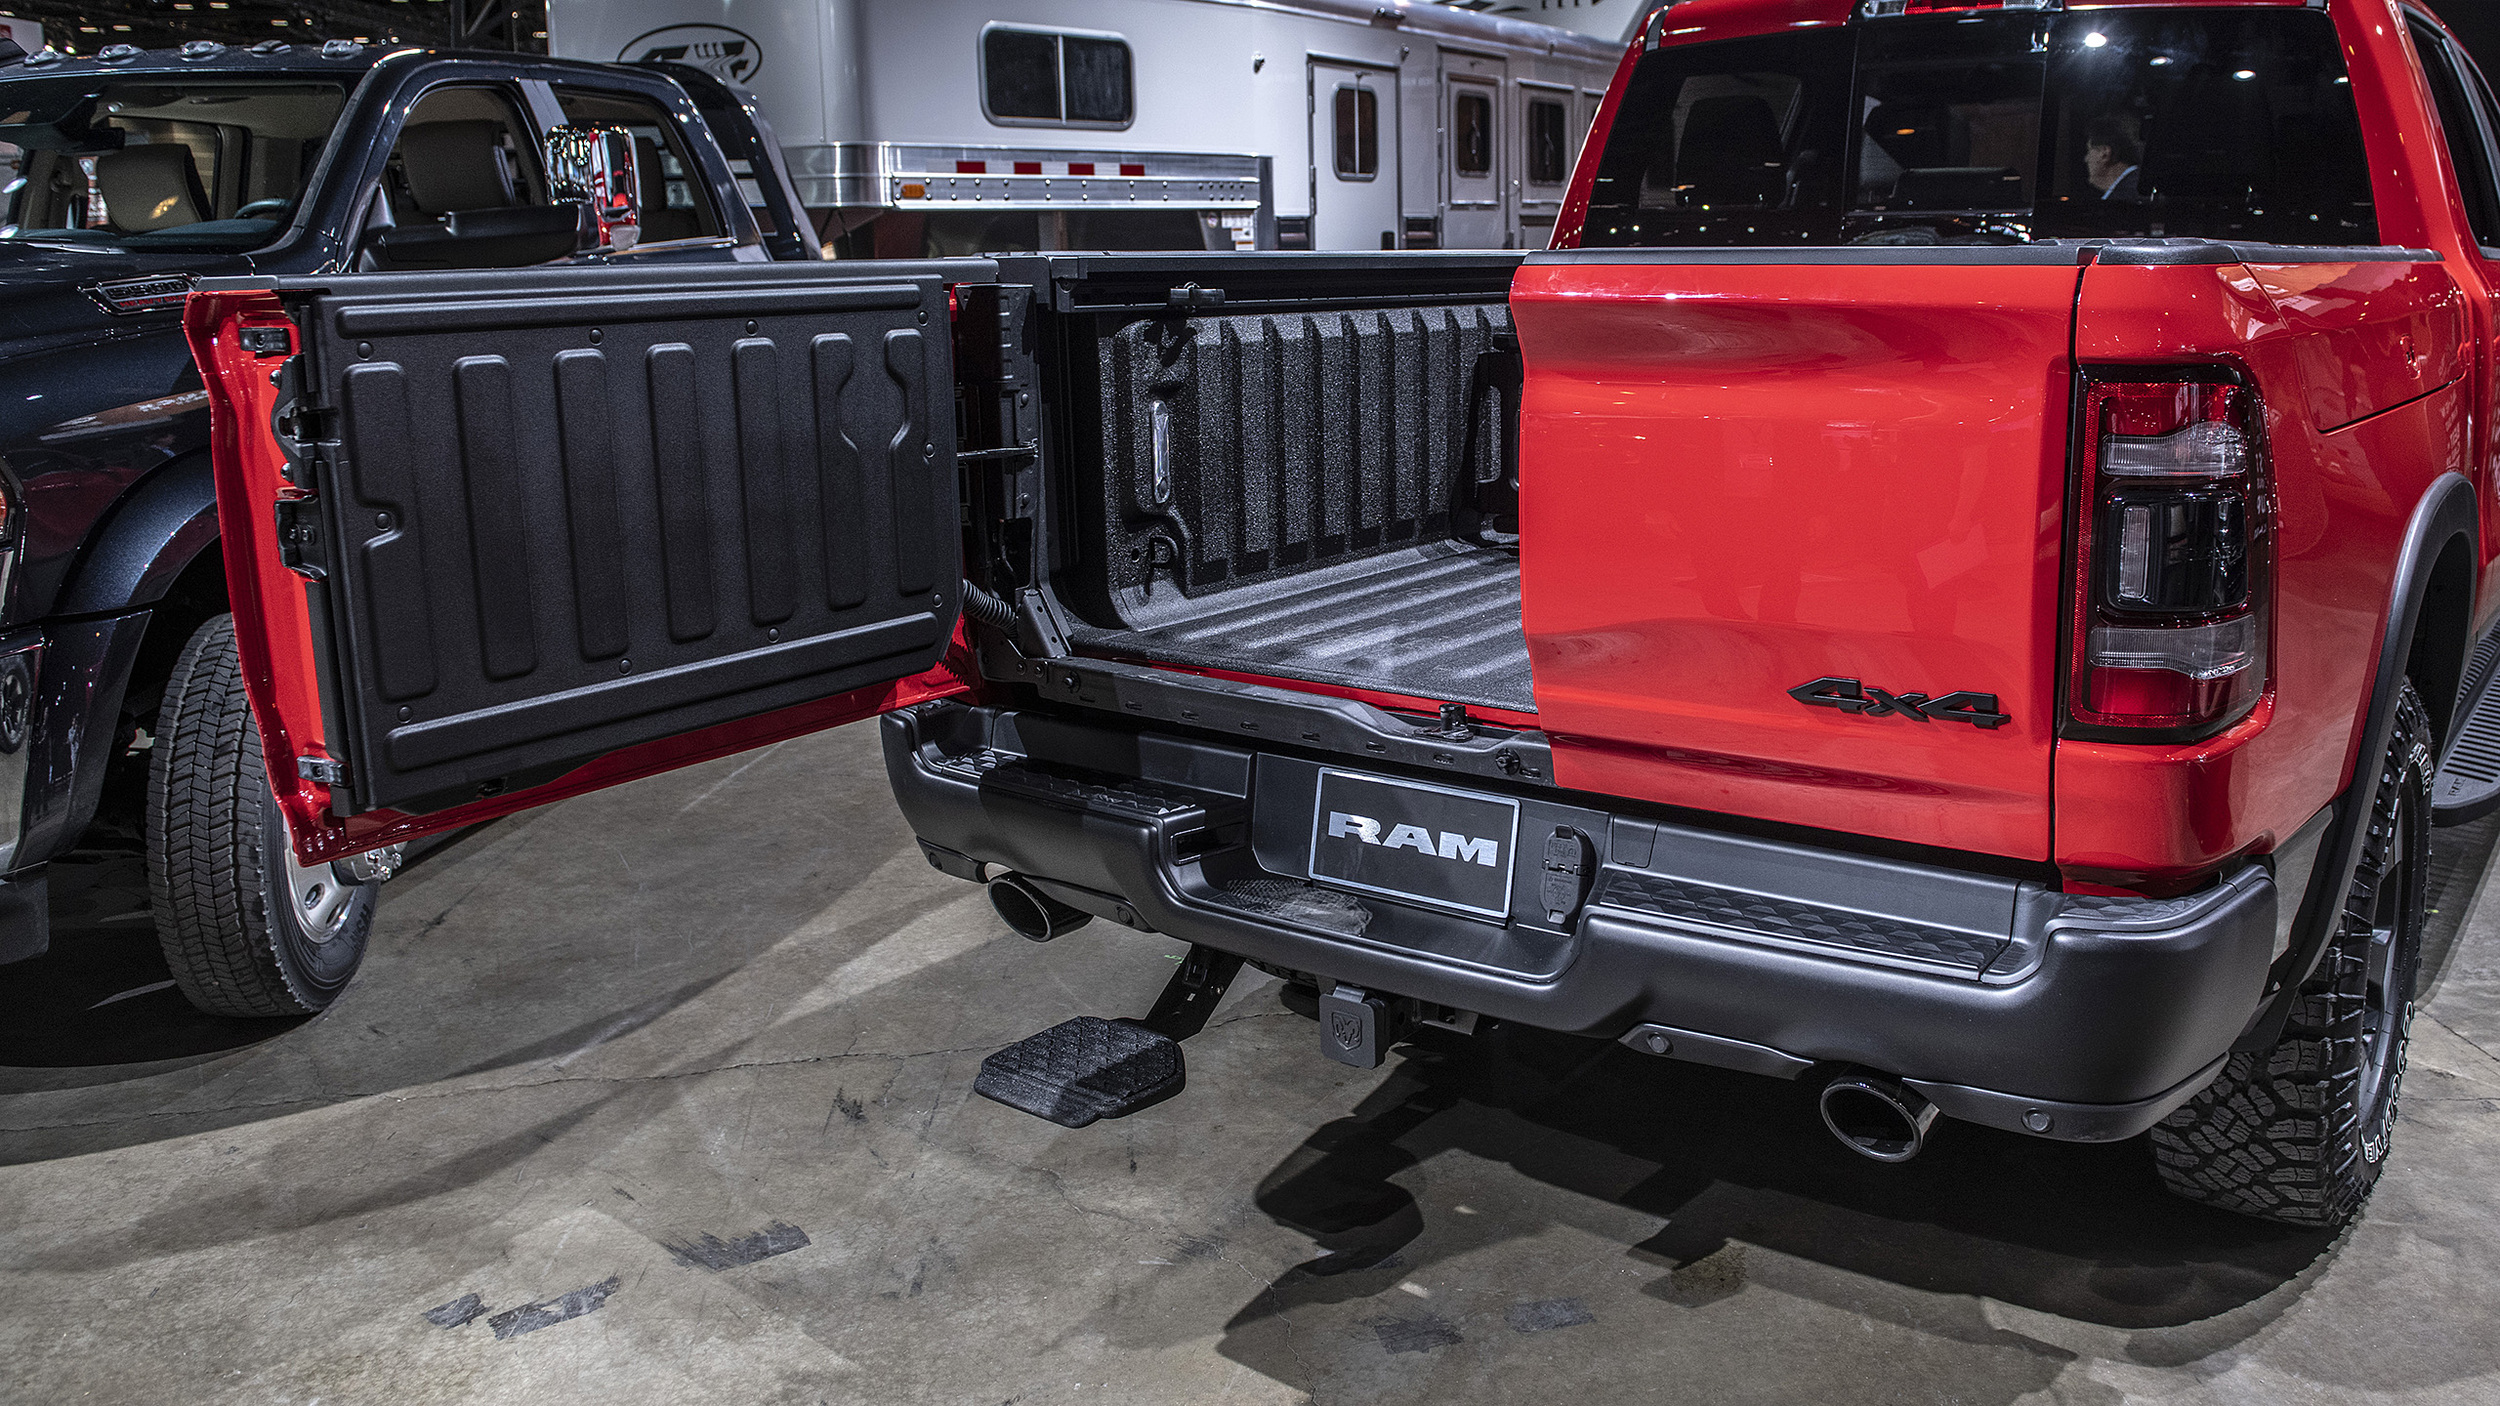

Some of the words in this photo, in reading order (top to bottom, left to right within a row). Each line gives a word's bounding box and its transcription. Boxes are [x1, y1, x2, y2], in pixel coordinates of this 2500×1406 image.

[1787, 677, 2011, 730] 4x4
[1328, 811, 1498, 868] RAM
[2362, 1000, 2414, 1163] GOODYE
